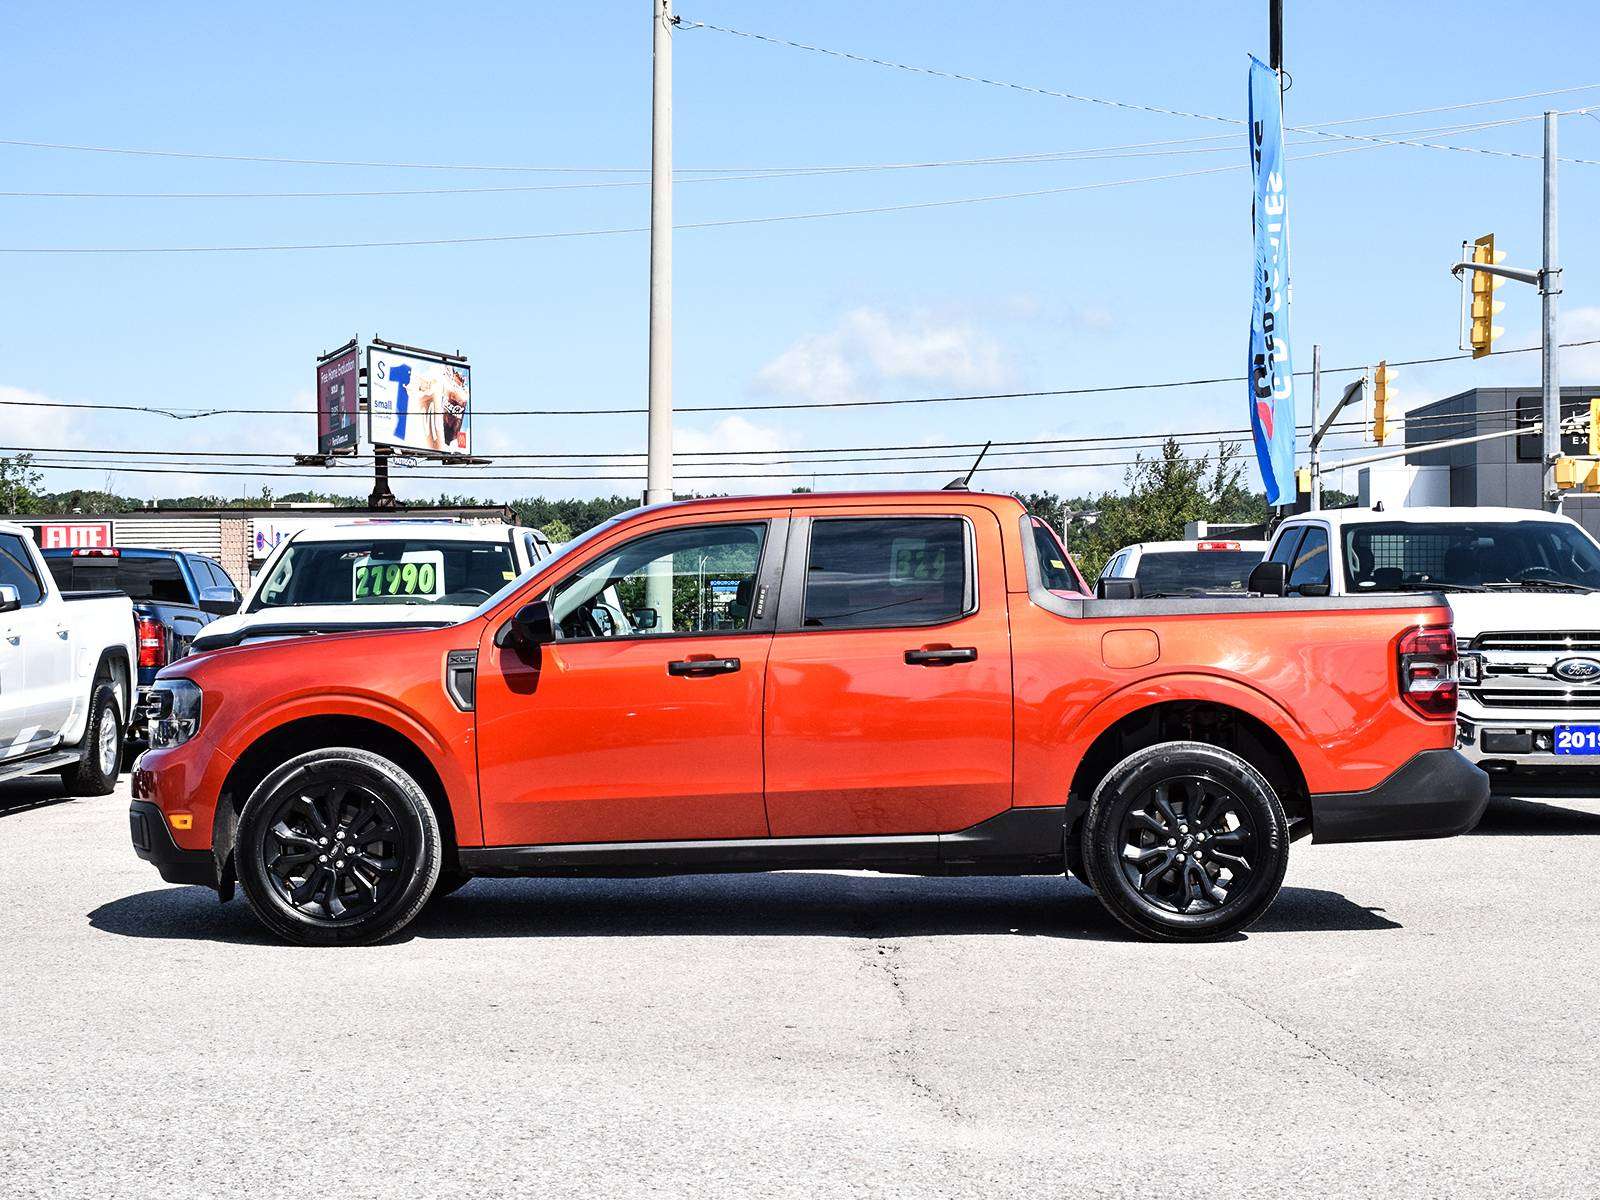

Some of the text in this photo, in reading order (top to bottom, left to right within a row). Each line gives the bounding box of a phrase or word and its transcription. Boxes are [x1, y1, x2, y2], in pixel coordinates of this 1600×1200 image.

[374, 400, 392, 411] small
[356, 563, 435, 596] 27990
[450, 656, 475, 664] XLT
[1568, 663, 1592, 676] Ford
